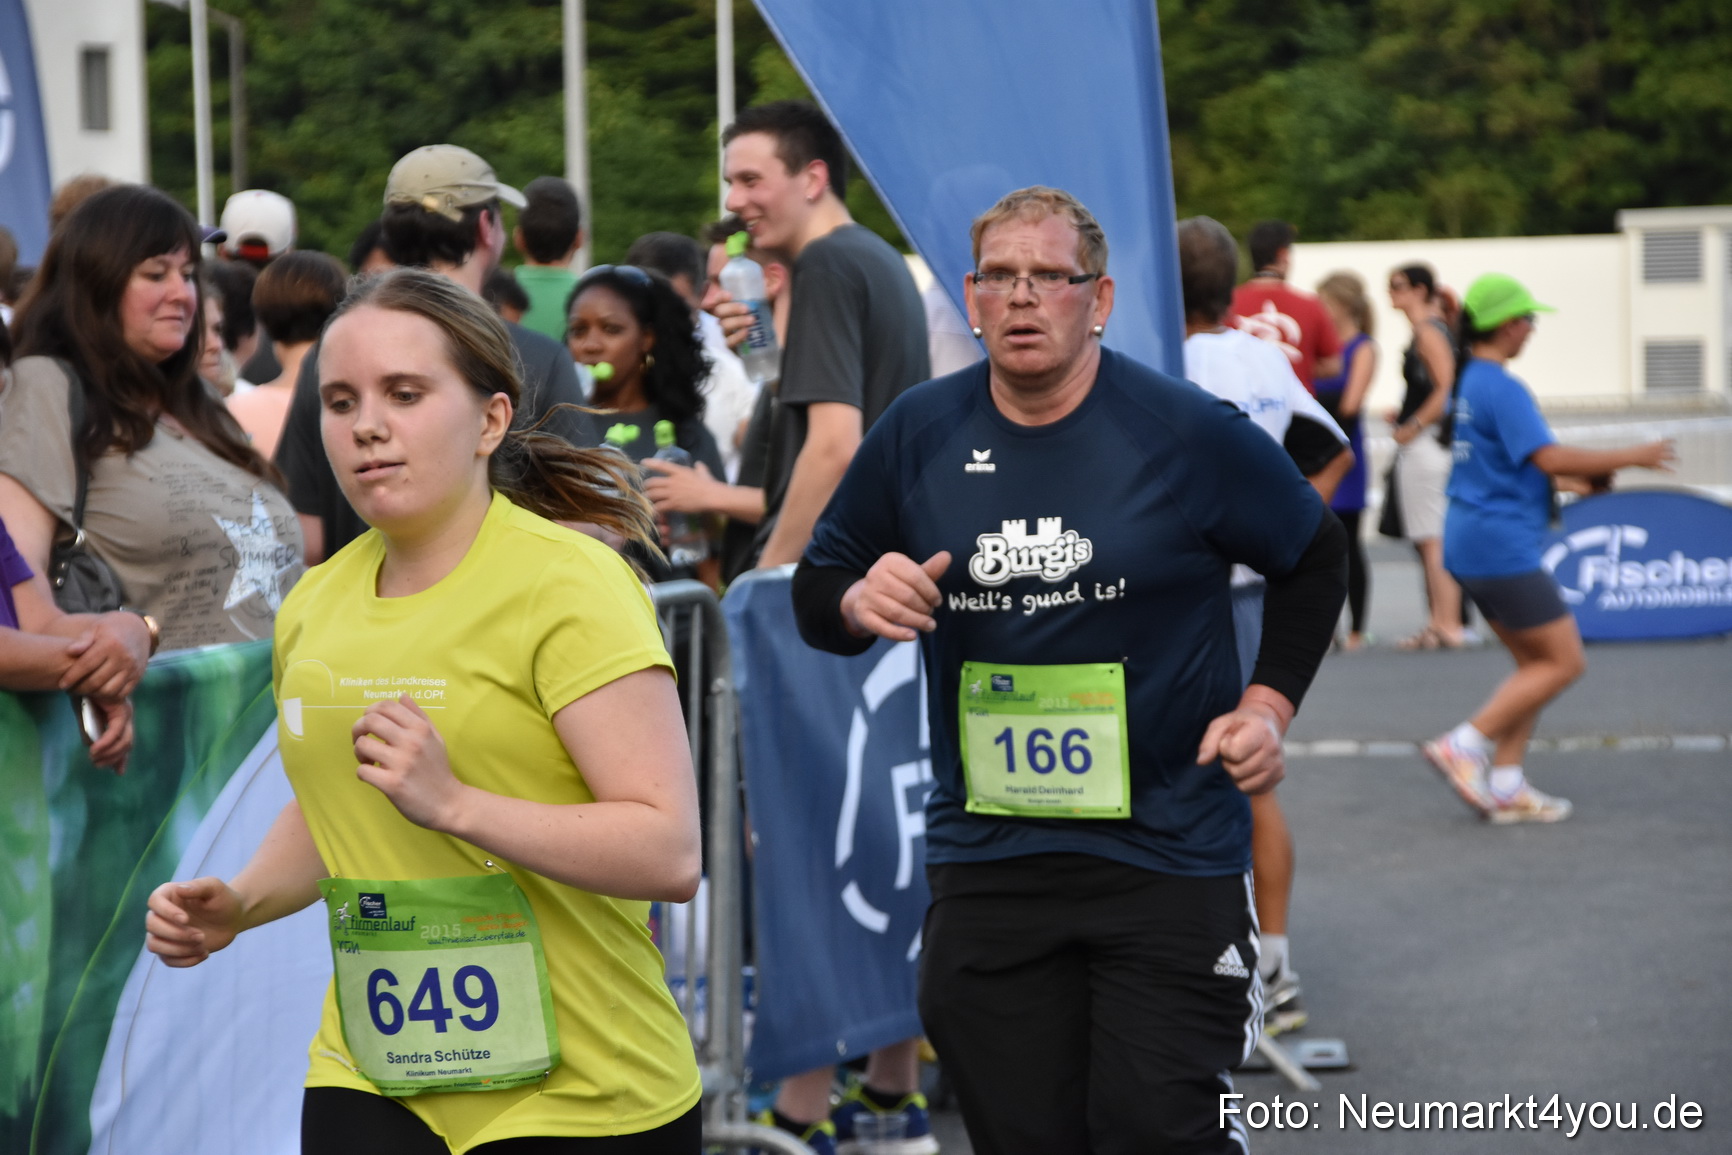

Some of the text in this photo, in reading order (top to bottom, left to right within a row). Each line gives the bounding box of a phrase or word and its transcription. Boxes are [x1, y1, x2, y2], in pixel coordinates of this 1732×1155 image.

[965, 462, 996, 473] erima
[218, 543, 298, 569] SUMMER
[968, 529, 1093, 586] Burgis
[948, 577, 1126, 616] Weil's guad is!
[340, 676, 447, 687] Kliniken des Landkreises
[994, 726, 1093, 775] 166
[1005, 785, 1084, 796] Harald Deinhard
[350, 915, 417, 931] firmenlauf
[420, 924, 461, 940] 2015
[1213, 963, 1250, 979] adidas
[367, 964, 500, 1036] 649
[386, 1048, 491, 1065] Sandra Schütze
[405, 1067, 473, 1077] Klinikum Neumarkt
